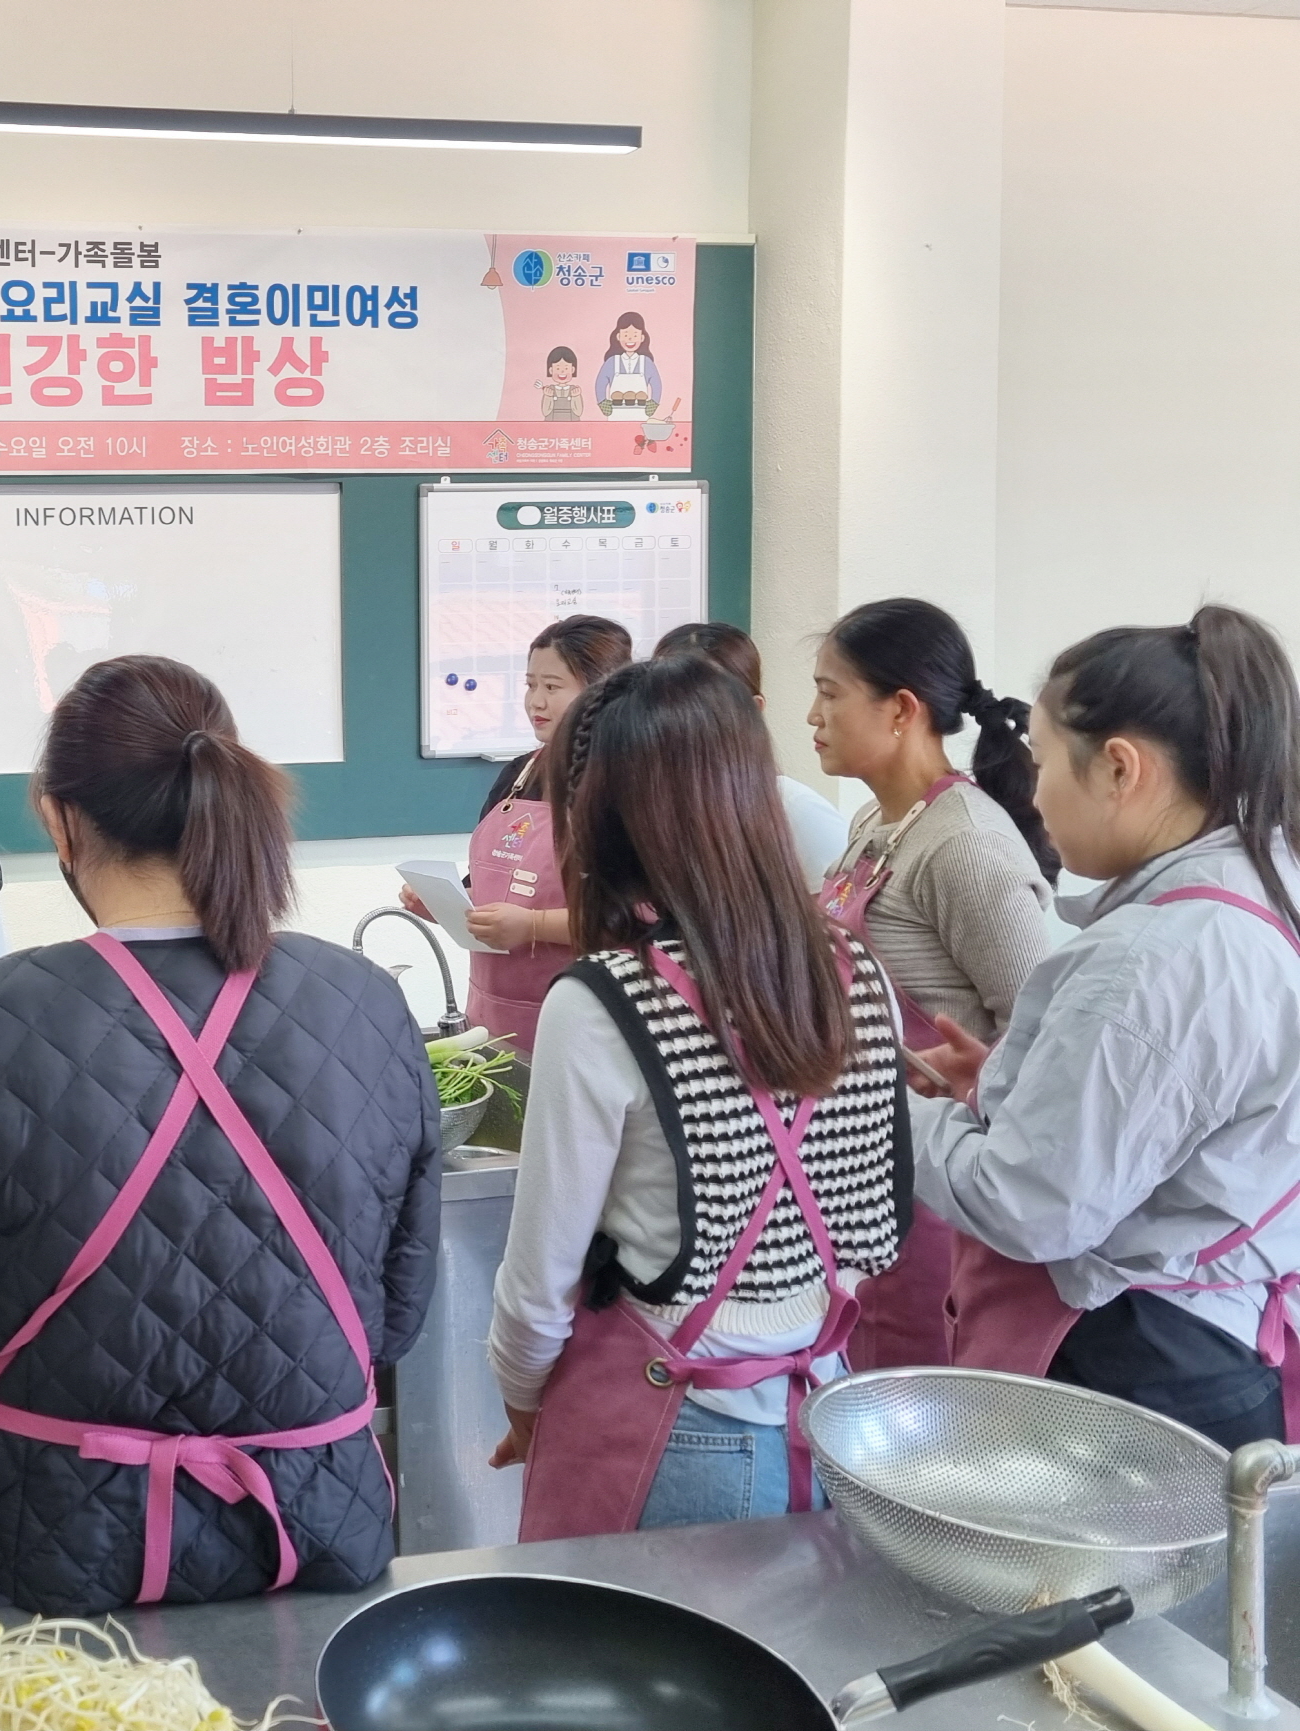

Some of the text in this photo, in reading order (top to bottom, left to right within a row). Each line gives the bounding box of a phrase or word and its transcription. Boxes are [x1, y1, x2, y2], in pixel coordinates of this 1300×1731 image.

[557, 253, 590, 262] 산소카페
[556, 265, 604, 287] 청송군
[626, 275, 676, 286] unesco
[0, 280, 163, 326] 요리교실
[184, 282, 420, 329] 결혼이민여성
[201, 334, 329, 407] 밥상
[56, 437, 95, 459] 오전
[105, 437, 146, 458] 10시
[181, 436, 219, 456] 장소
[240, 436, 351, 457] 노인여성회관
[360, 436, 390, 456] 2층
[399, 436, 451, 457] 조리실
[517, 438, 591, 450] 청송군가족센터
[16, 506, 194, 526] INFORMATION
[543, 506, 617, 524] 월중행사표
[451, 541, 461, 551] 일
[488, 540, 497, 550] 월
[525, 540, 534, 549] 화
[561, 540, 571, 549] 수
[598, 539, 607, 548] 목
[634, 538, 643, 548] 금
[671, 537, 679, 546] 토
